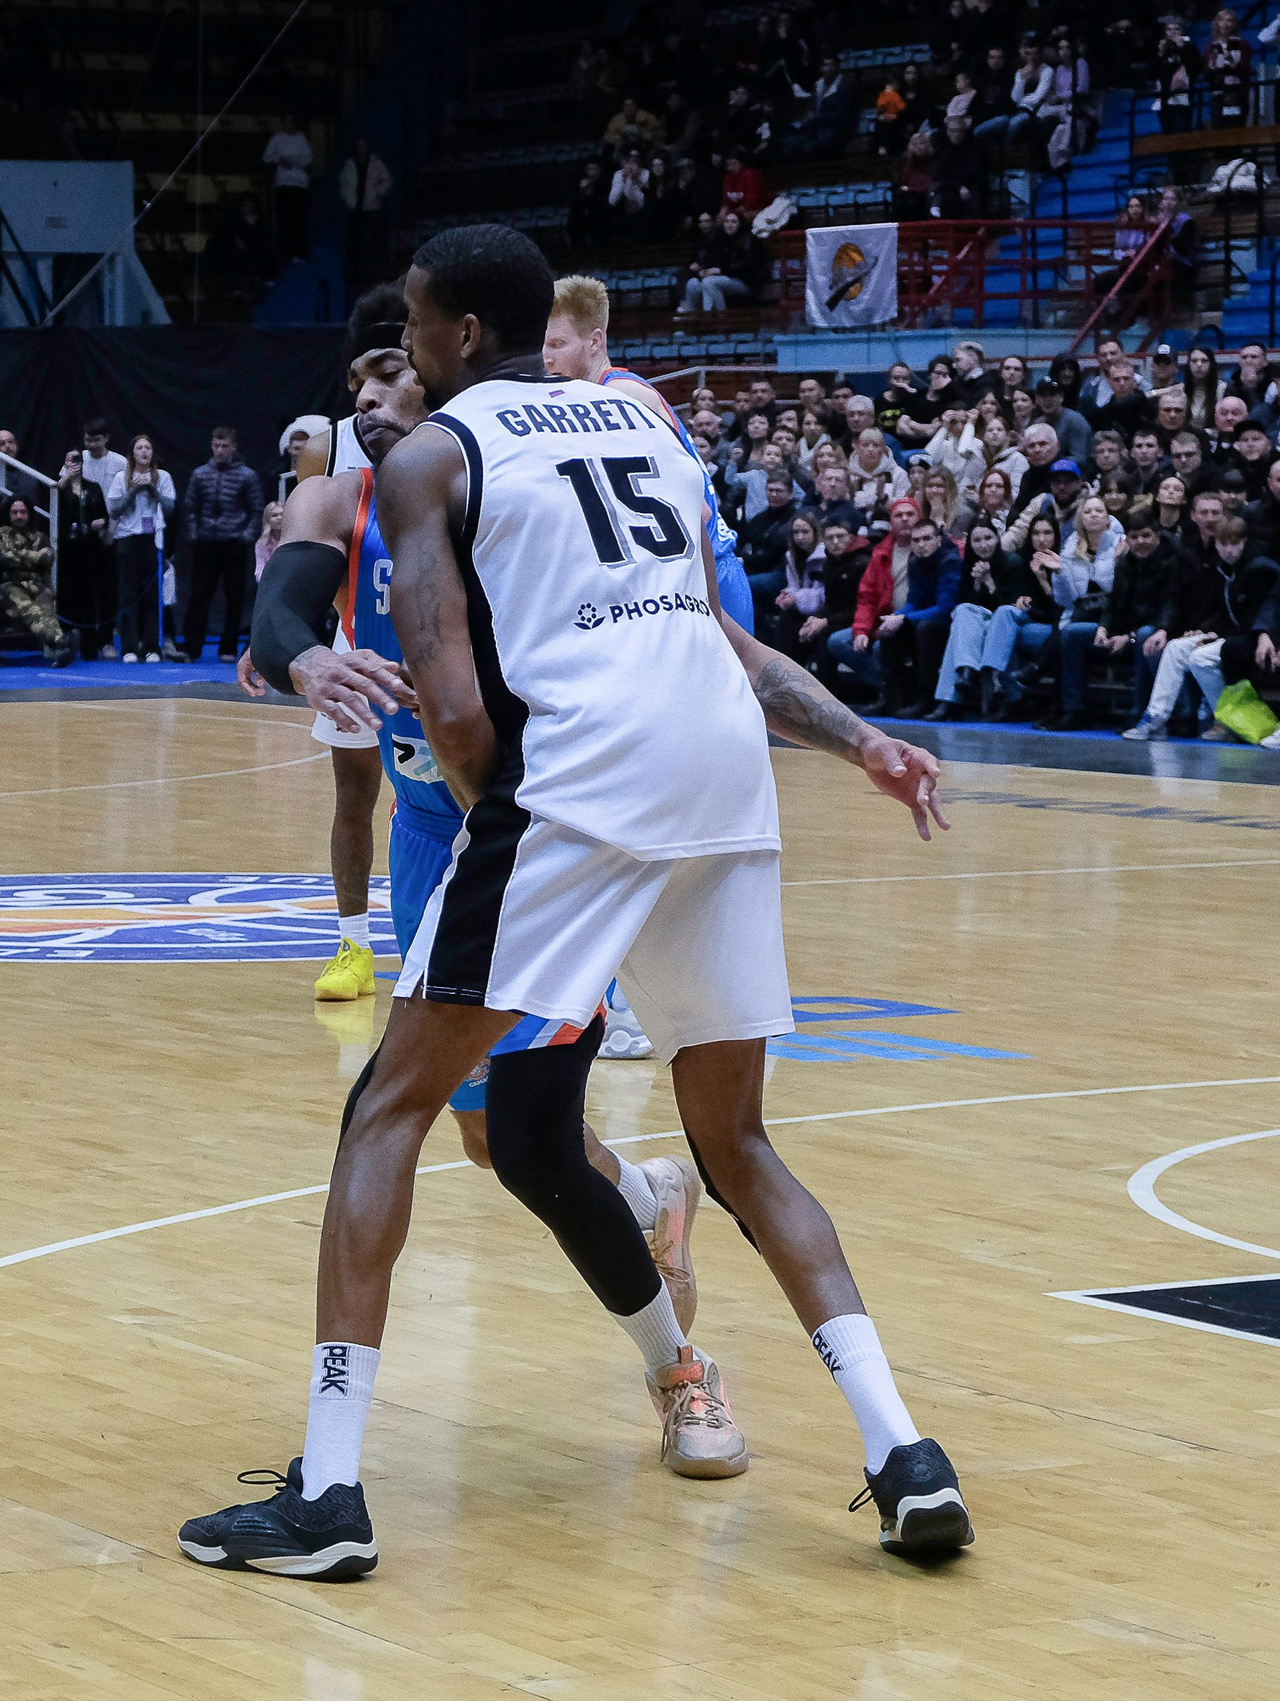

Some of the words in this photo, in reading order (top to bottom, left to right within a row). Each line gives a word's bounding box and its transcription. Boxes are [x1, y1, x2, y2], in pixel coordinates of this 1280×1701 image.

[555, 456, 695, 569] 15
[609, 592, 710, 624] PHOSAGRO
[319, 1345, 350, 1396] PEAK
